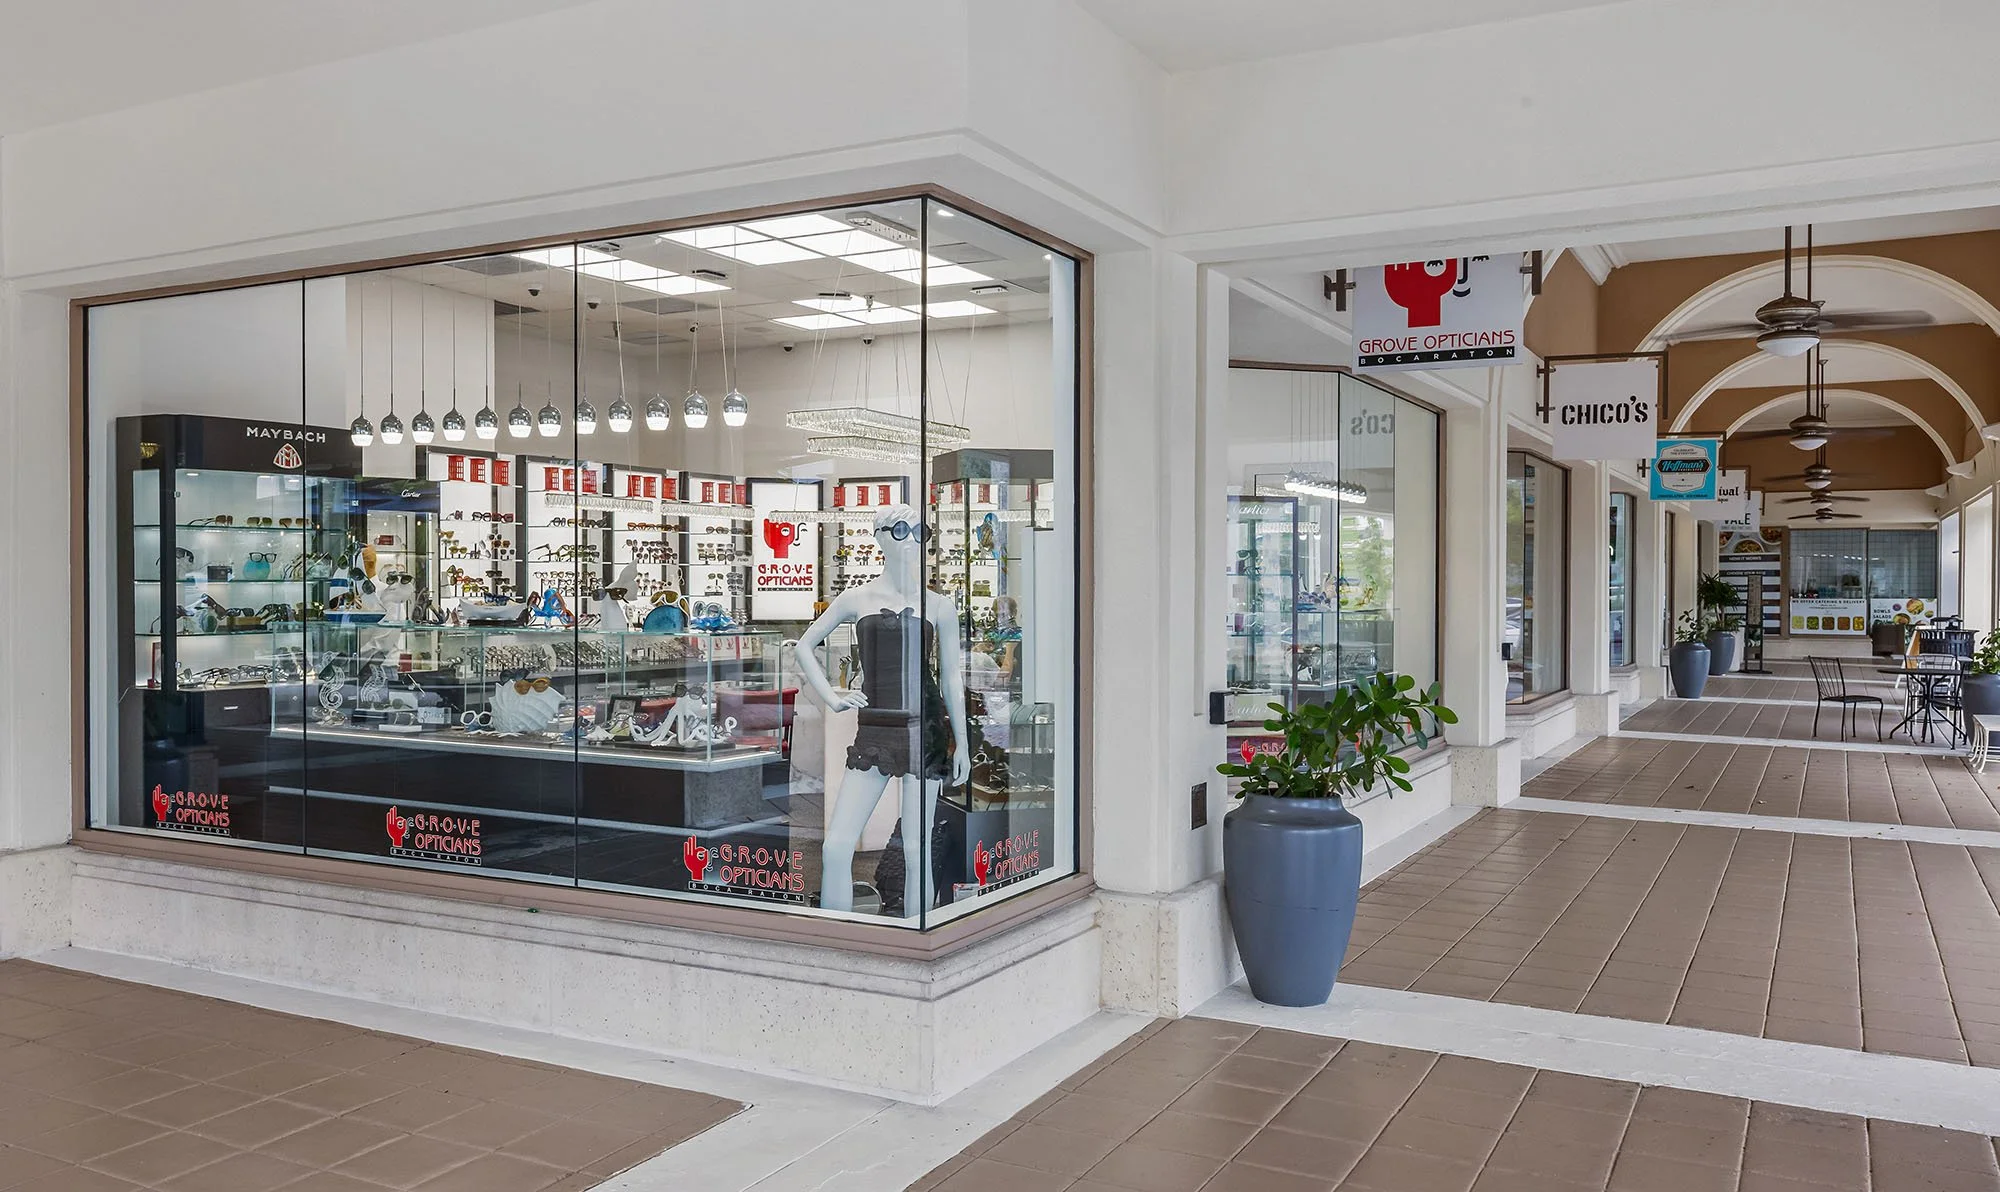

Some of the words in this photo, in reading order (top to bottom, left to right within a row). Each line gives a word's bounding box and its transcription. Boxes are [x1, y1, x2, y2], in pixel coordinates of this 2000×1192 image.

[1359, 336, 1418, 354] GROVE
[1423, 329, 1516, 350] OPTICIANS
[1561, 395, 1648, 425] CHICO'S
[246, 426, 326, 443] MAYBACH
[1661, 460, 1704, 472] Hoffman's
[757, 575, 814, 586] OPTICIANS
[175, 807, 230, 828] OPTICIANS
[414, 832, 481, 856] OPTICIANS
[995, 850, 1040, 880] OPTICIANS
[720, 865, 805, 892] OPTICIANS
[691, 882, 732, 893] BOCA
[747, 888, 801, 901] RATON
